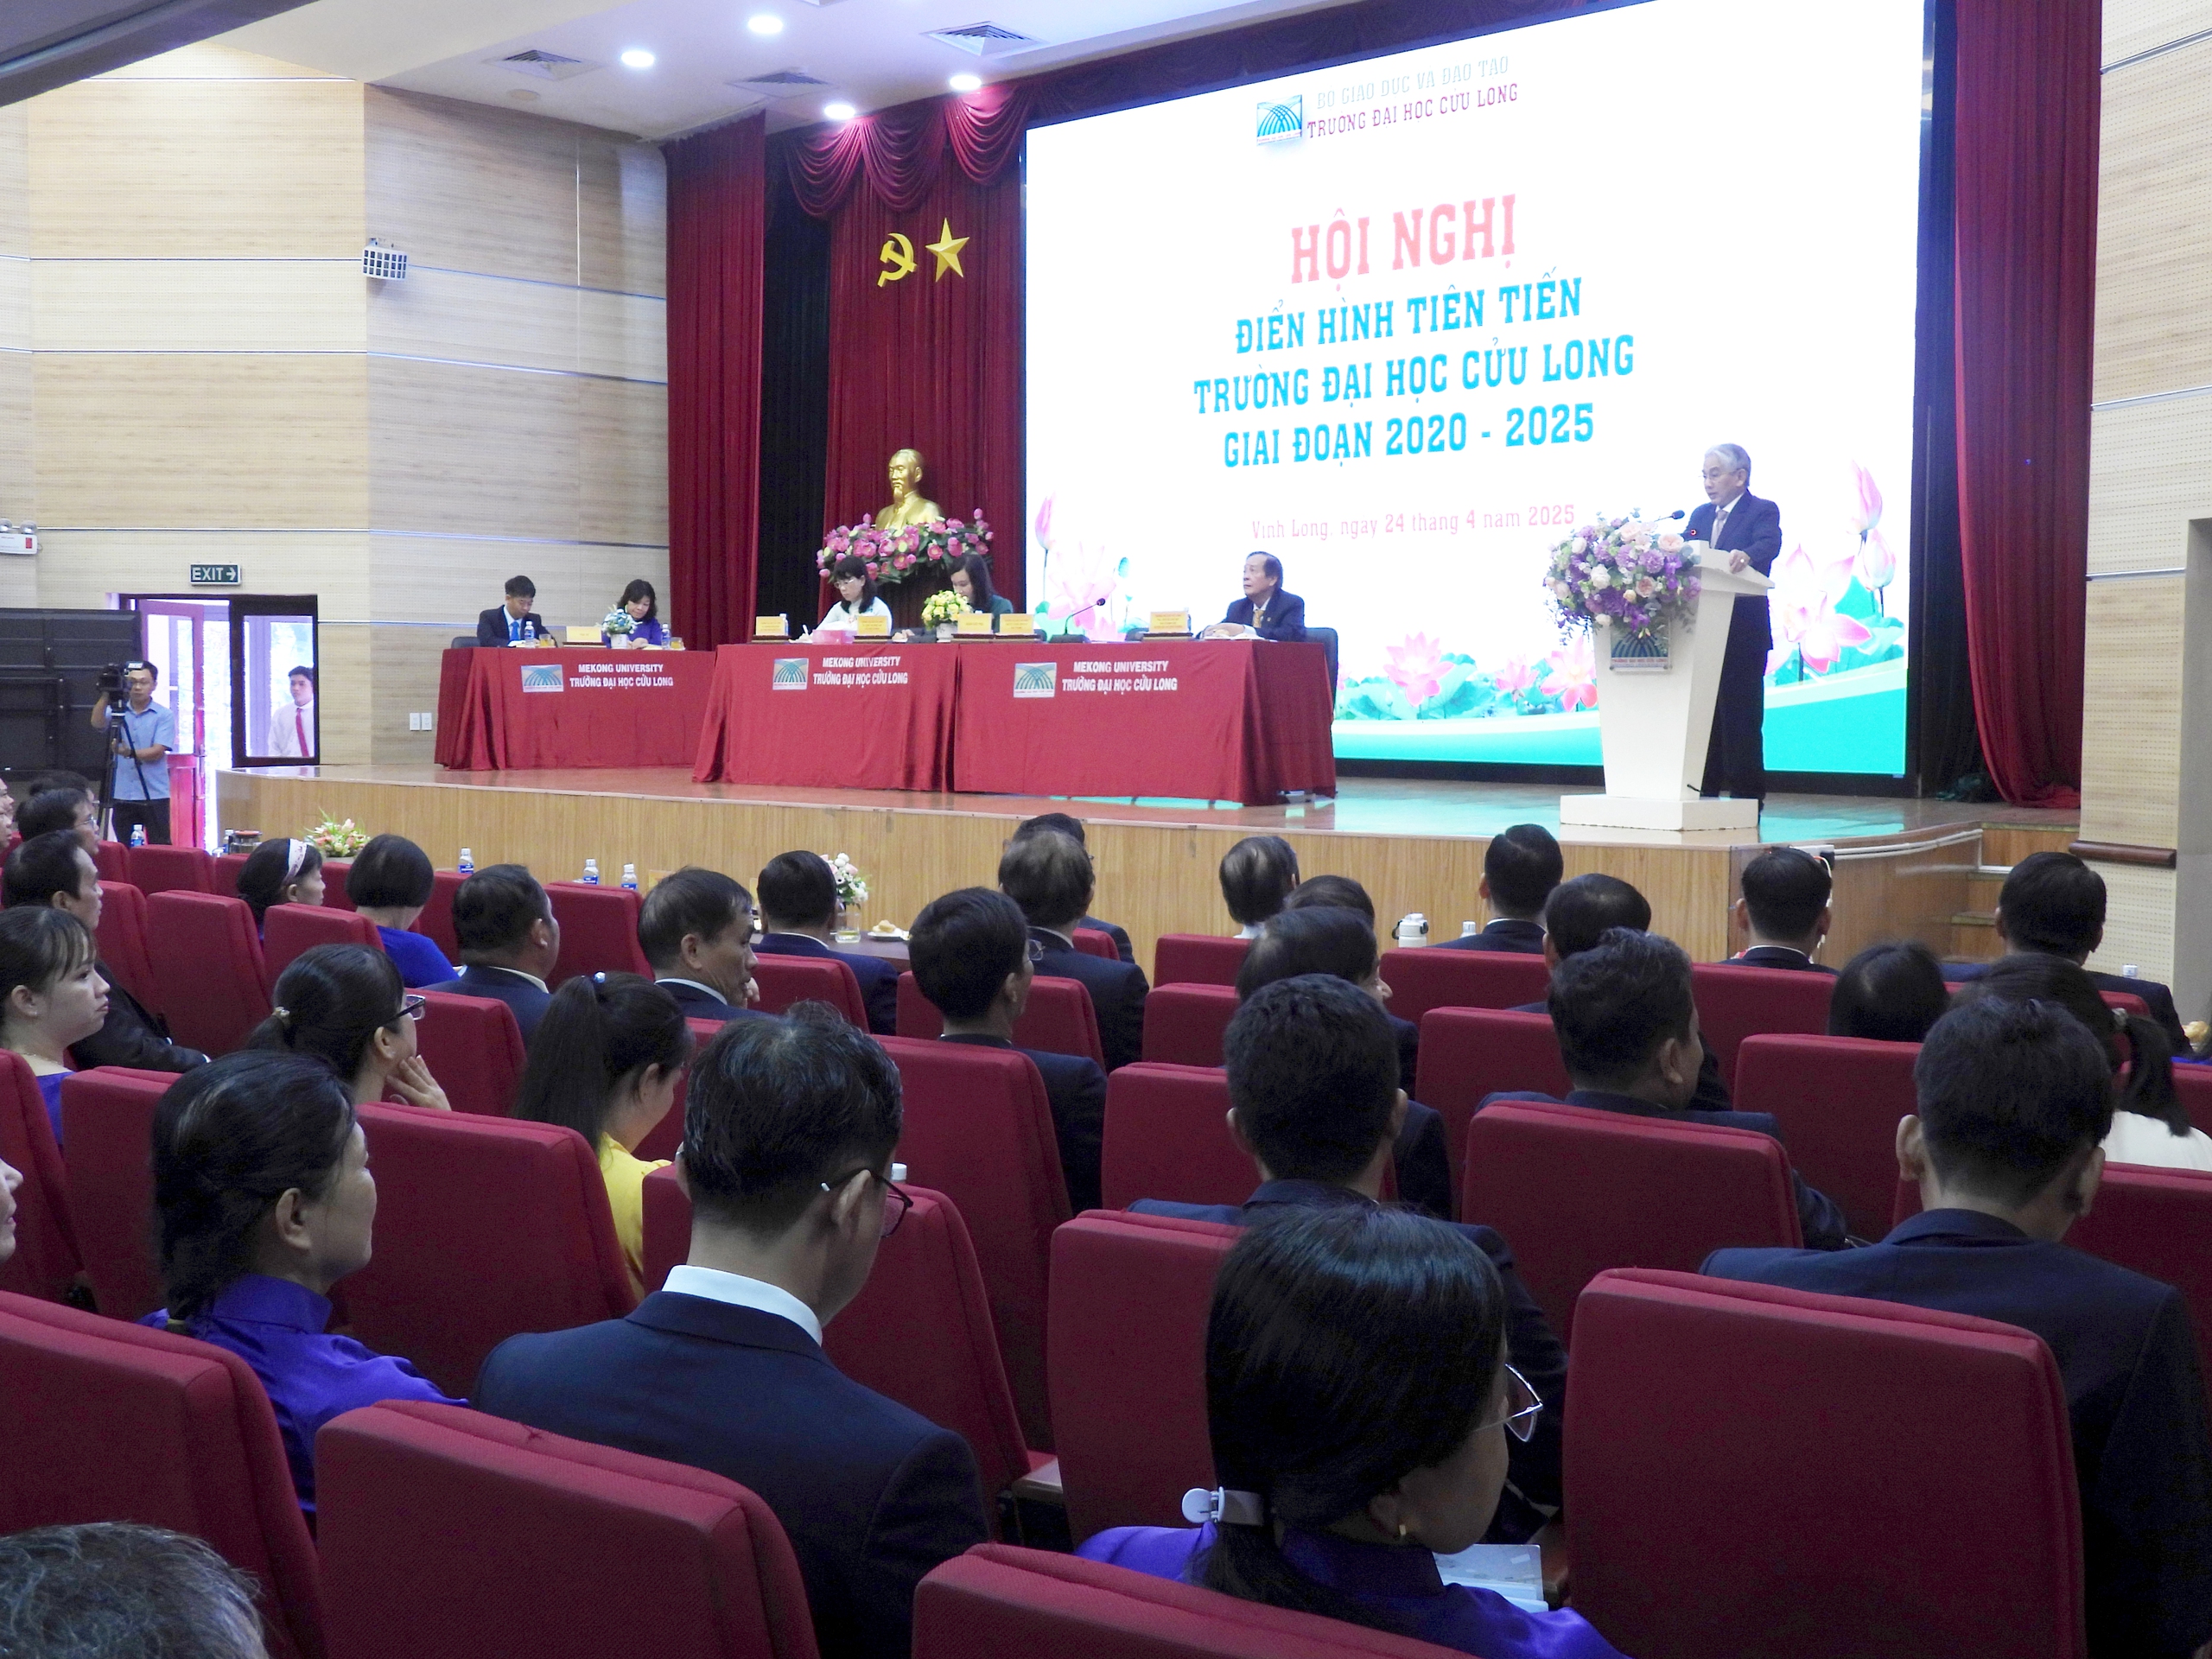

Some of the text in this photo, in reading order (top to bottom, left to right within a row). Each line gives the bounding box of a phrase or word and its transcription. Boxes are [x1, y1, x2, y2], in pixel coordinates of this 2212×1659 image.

[1477, 82, 1518, 108] LONG
[1291, 194, 1516, 292] HỘI NGHỊ
[1235, 266, 1582, 354] ĐIỂN HÌNH TIÊN TIẾN
[1193, 334, 1635, 415] TRƯỜNG ĐẠI HỌC CỬU LONG
[1224, 402, 1594, 468] GIAI ĐOẠN 2020 - 2025
[1384, 512, 1405, 533] 24
[1465, 509, 1476, 530] 4
[1528, 504, 1575, 526] 2025
[192, 567, 225, 581] EXIT
[578, 664, 664, 673] MEKONG UNIVERSITY
[822, 656, 901, 667] MEKONG UNIVERSITY
[1073, 660, 1169, 672] MEKONG UNIVERSITY
[653, 677, 673, 687] LONG
[887, 672, 908, 684] LONG
[1096, 678, 1112, 695] ĐẠI
[1113, 678, 1133, 695] HỌC
[1154, 677, 1178, 691] LONG
